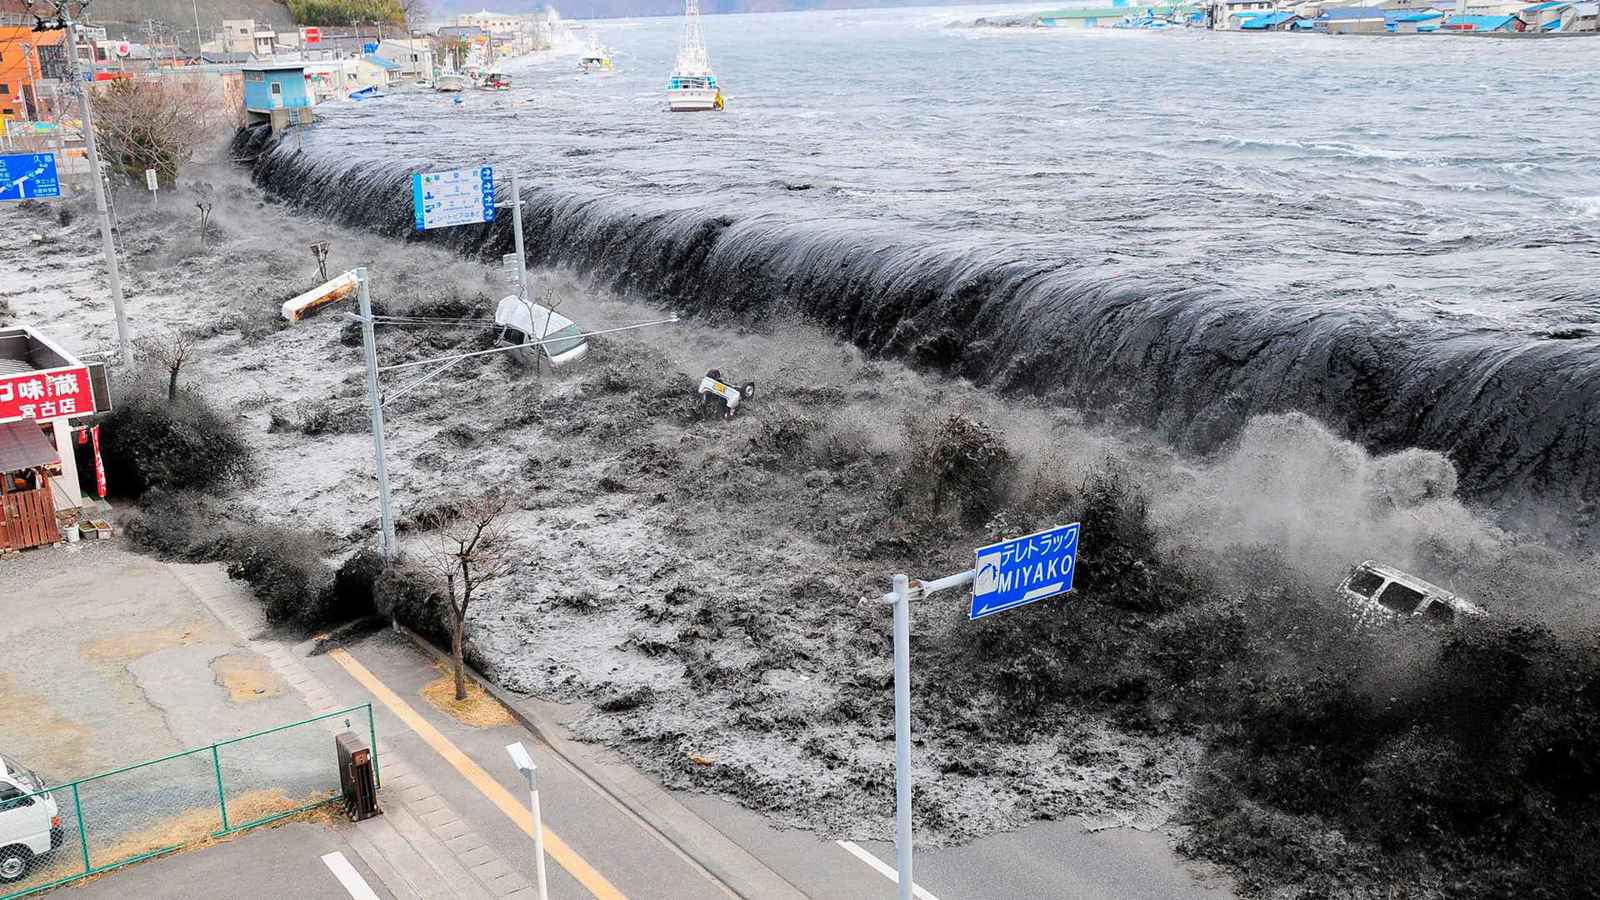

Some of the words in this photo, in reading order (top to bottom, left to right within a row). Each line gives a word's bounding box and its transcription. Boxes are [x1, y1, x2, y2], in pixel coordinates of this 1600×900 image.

[19, 398, 76, 418] 宮古店
[1001, 527, 1077, 566] テレトラック
[998, 554, 1072, 594] MIYAKO
